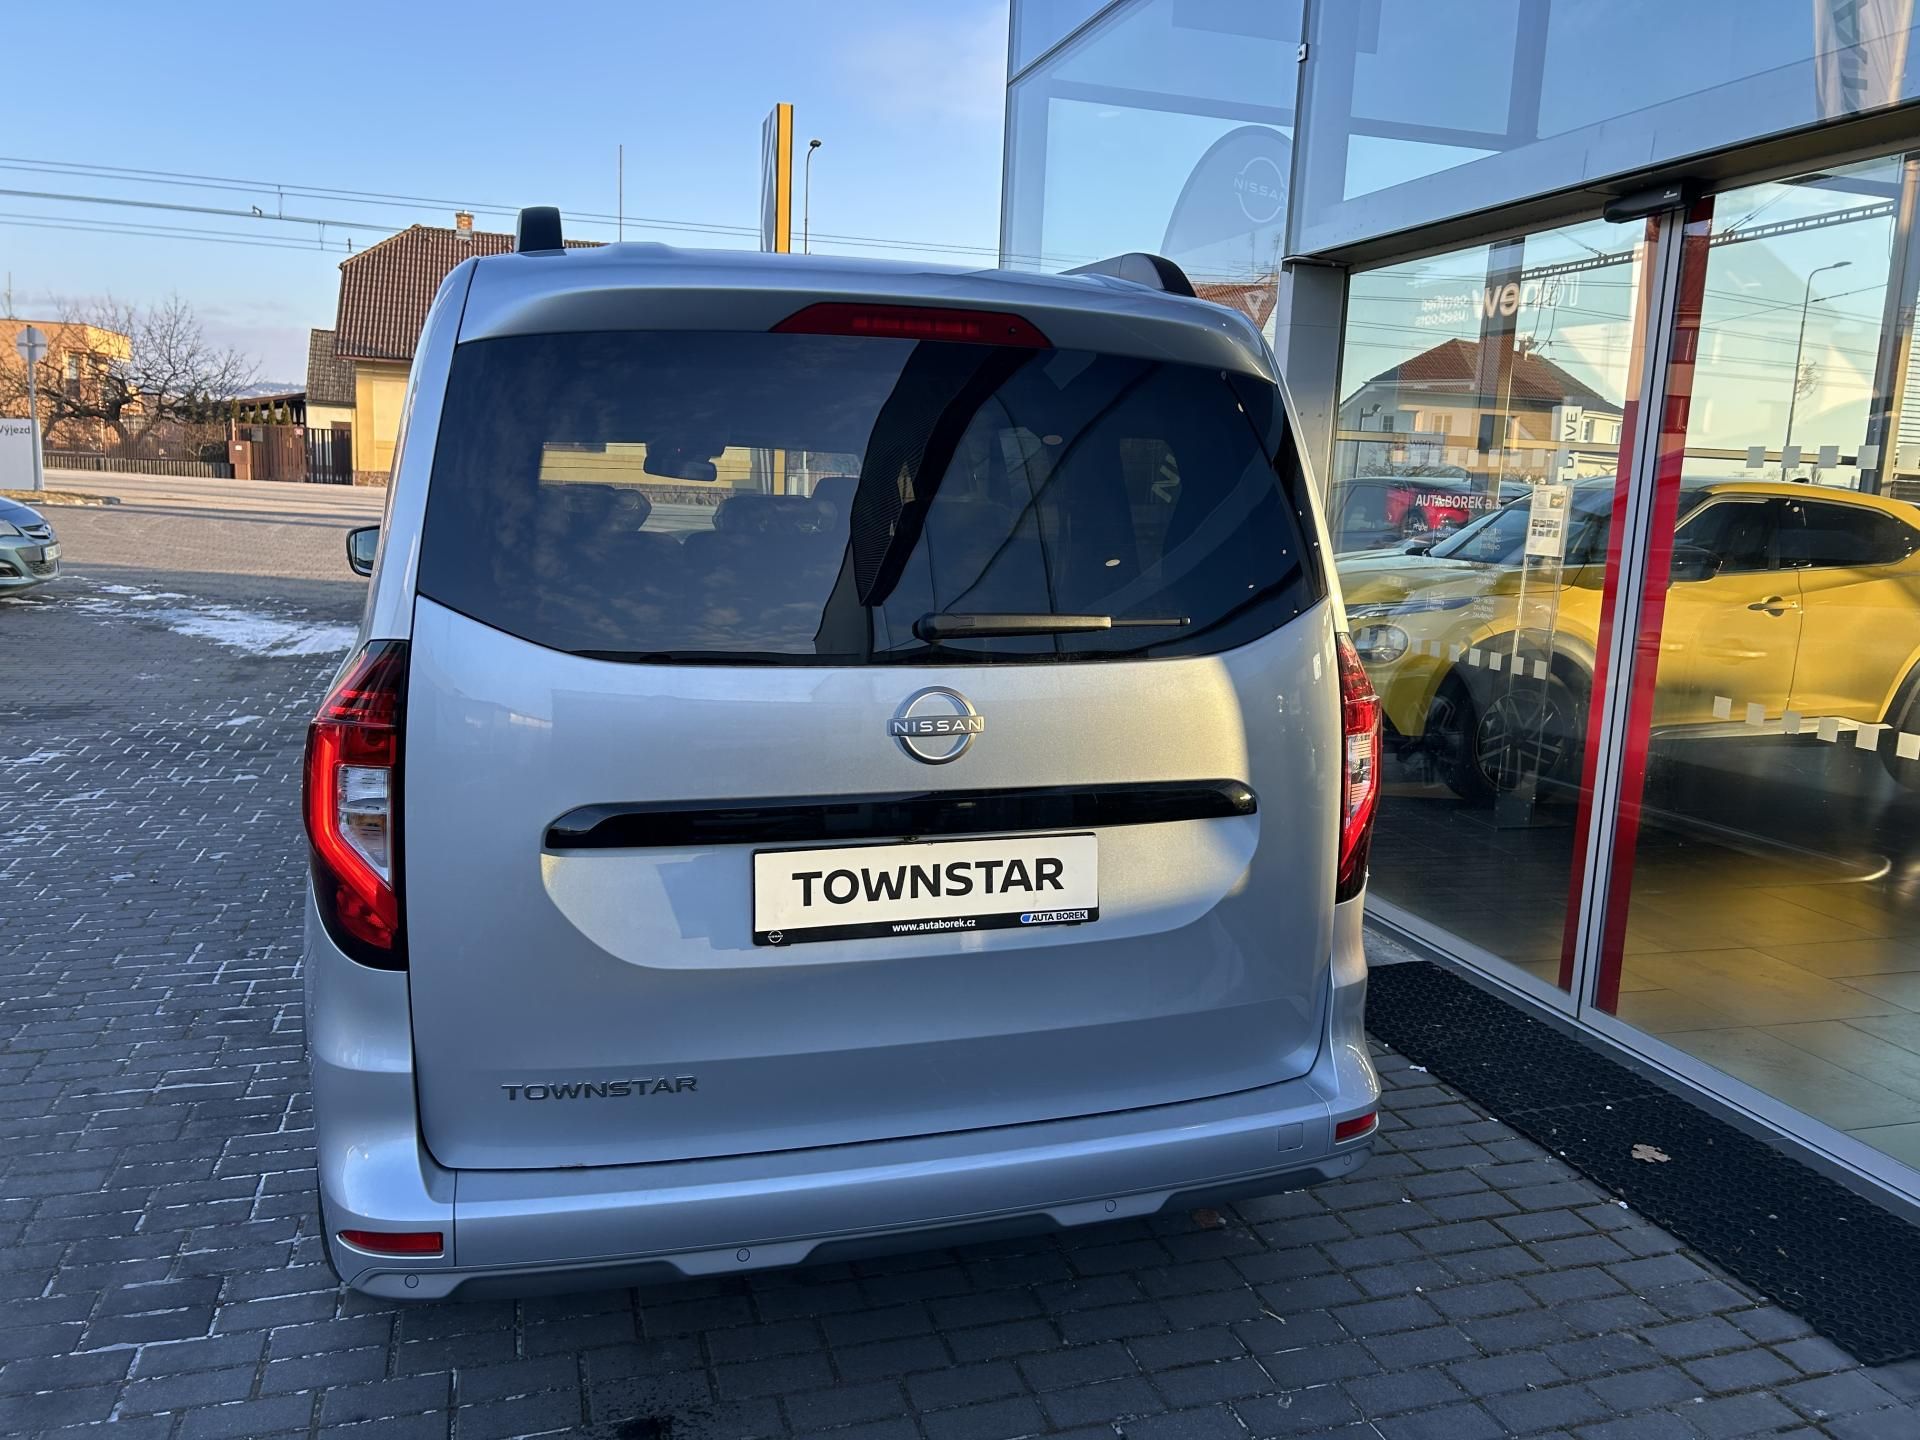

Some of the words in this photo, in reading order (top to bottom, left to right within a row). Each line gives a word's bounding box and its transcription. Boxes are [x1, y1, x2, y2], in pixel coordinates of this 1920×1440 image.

[1446, 495, 1483, 510] BOREK
[894, 719, 981, 733] NISSAN
[792, 857, 1064, 908] TOWNSTAR
[1031, 913, 1055, 922] AUTA
[1056, 911, 1087, 920] BOREK
[892, 918, 976, 933] www.autaborek.cz
[501, 1075, 698, 1101] TOWNSTAR
